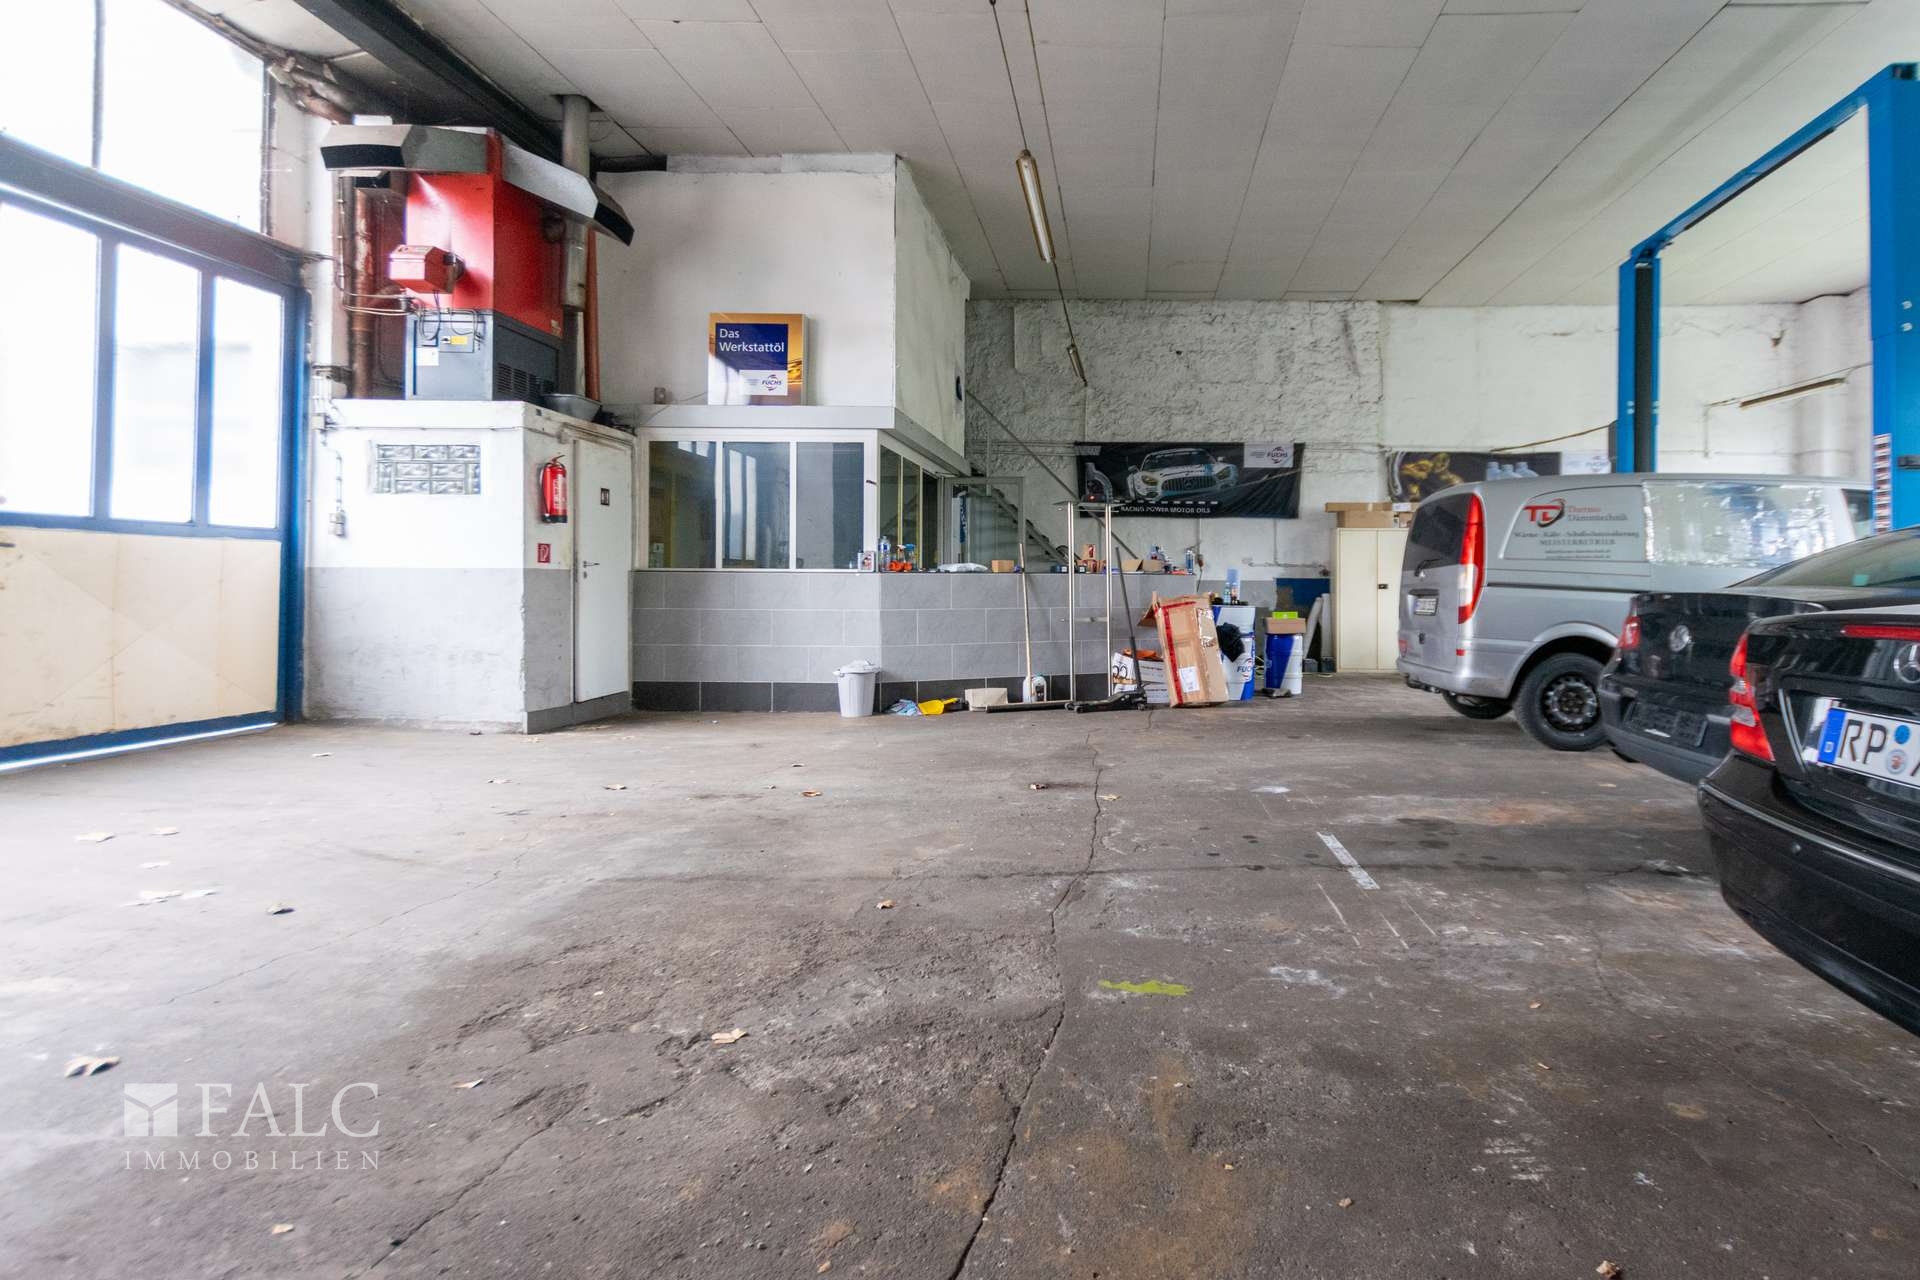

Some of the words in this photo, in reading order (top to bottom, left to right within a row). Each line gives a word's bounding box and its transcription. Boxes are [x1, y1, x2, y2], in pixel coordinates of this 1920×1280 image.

[719, 328, 740, 338] Das
[719, 342, 785, 352] Werkstattöl
[1839, 719, 1887, 765] RP
